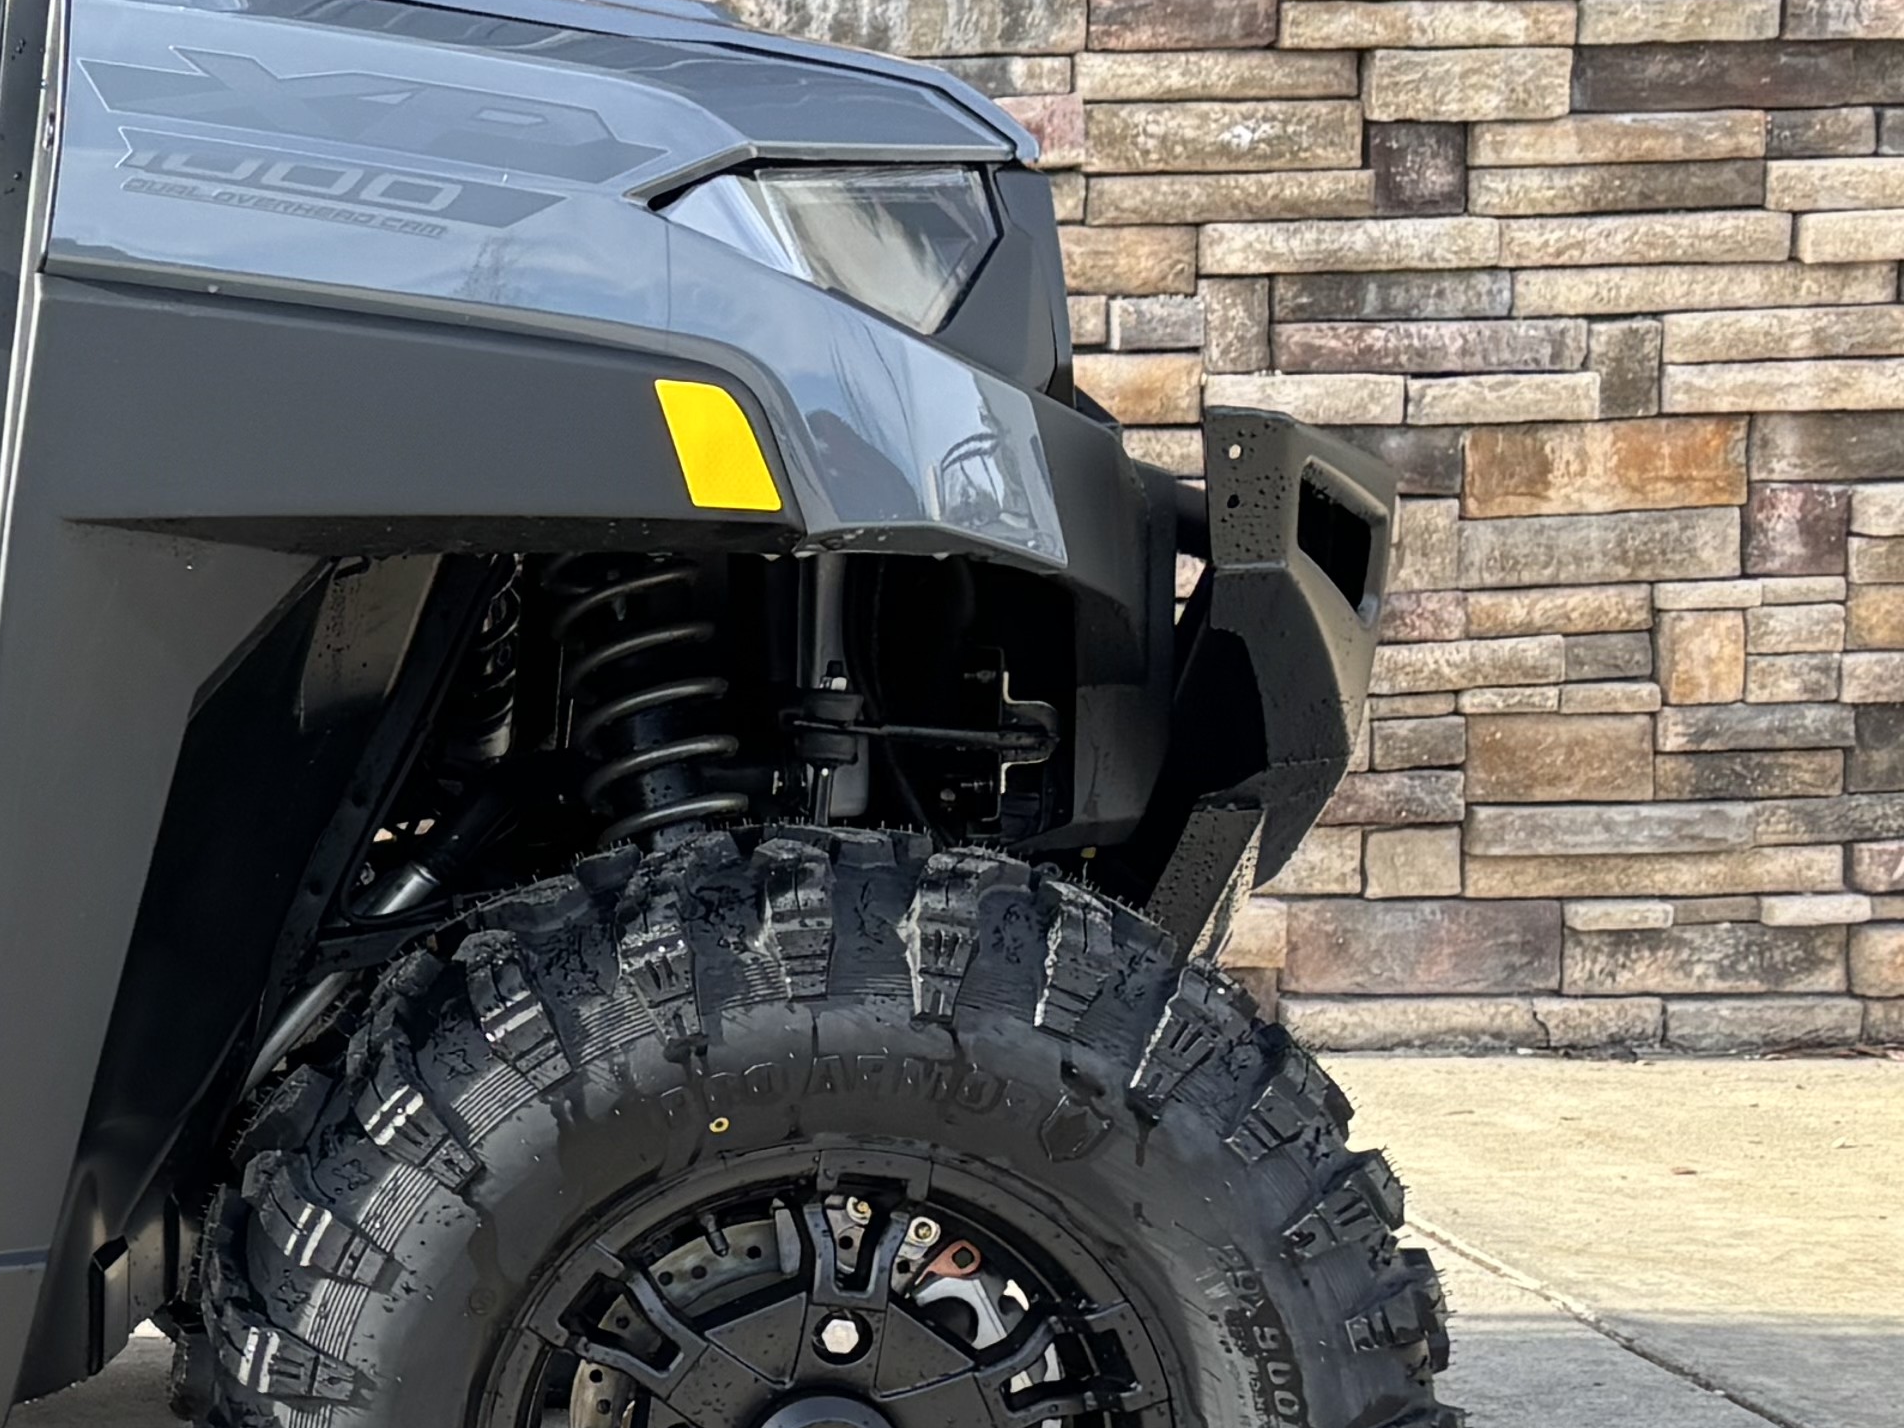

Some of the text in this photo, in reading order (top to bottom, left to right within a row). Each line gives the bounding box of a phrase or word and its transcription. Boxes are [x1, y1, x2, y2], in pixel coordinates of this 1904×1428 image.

[77, 46, 670, 184] XP
[122, 137, 463, 212] 1000
[126, 177, 448, 238] DUAL OVERHEAD CAM
[659, 1053, 1042, 1130] PRO ARMOR
